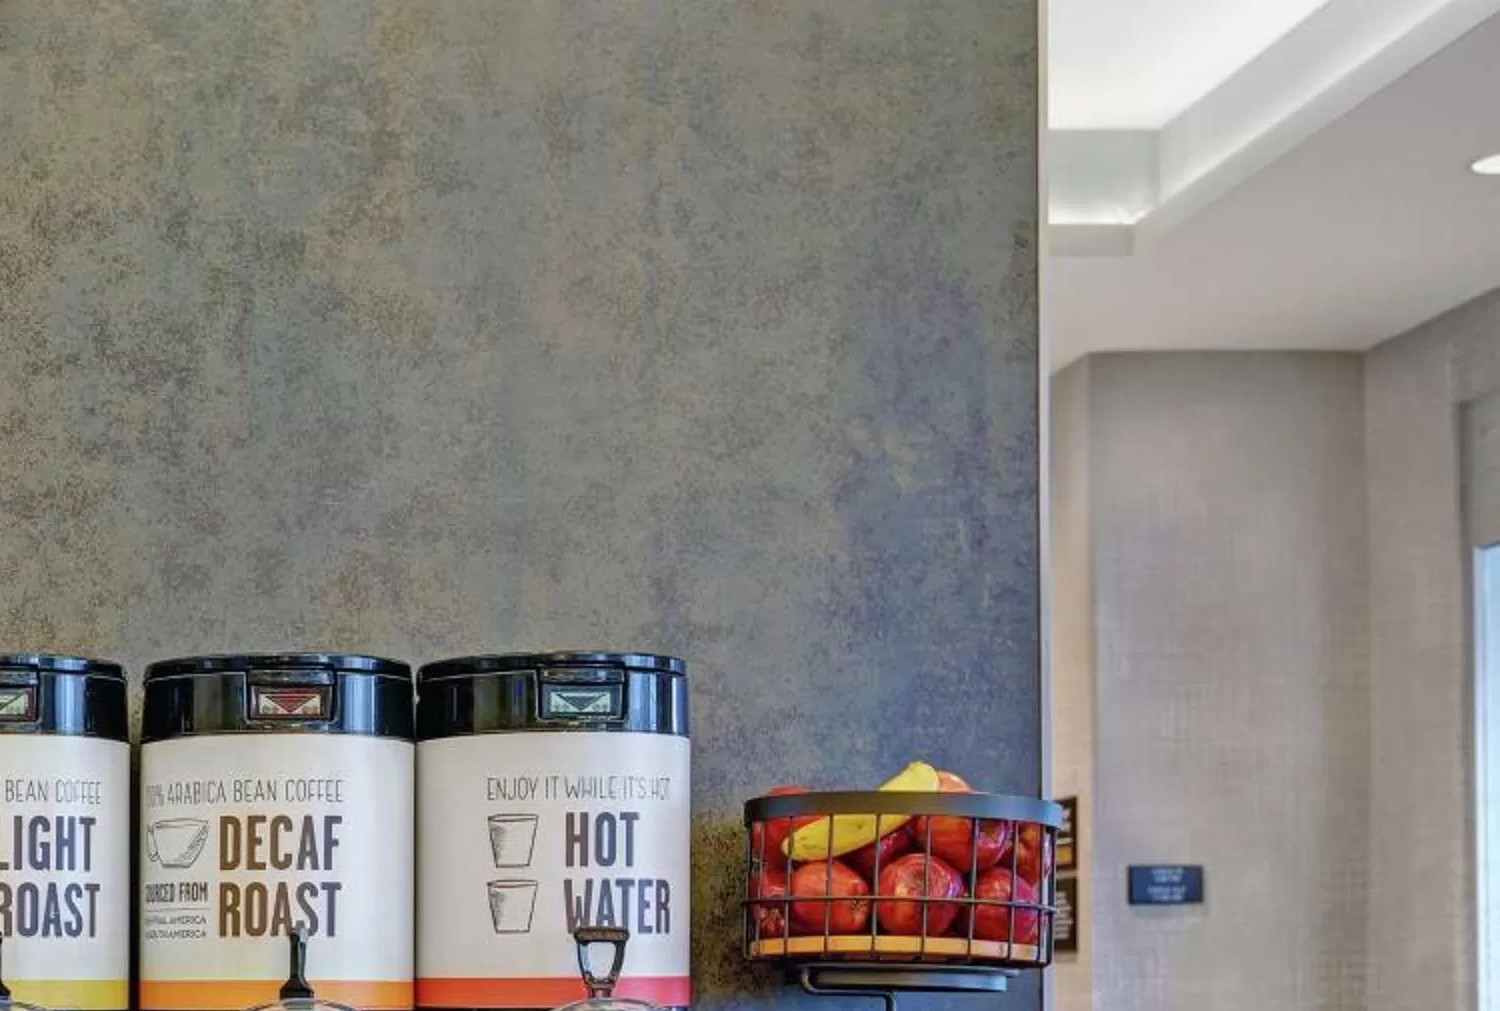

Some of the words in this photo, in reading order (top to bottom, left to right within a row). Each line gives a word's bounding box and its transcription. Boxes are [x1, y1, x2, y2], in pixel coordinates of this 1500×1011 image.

[5, 778, 49, 803] BEAN
[55, 778, 101, 805] COFFEE
[167, 780, 227, 806] ARABICA
[233, 779, 278, 803] BEAN
[285, 779, 344, 804] COFFEE
[487, 777, 539, 801] ENJOY
[545, 775, 560, 800] IT
[564, 775, 618, 800] WHILE
[623, 775, 647, 800] IT'S
[219, 814, 343, 871] DECAF
[565, 811, 640, 868] HOT
[179, 881, 209, 903] FROM
[219, 881, 342, 938] ROAST
[563, 877, 671, 935] WATER
